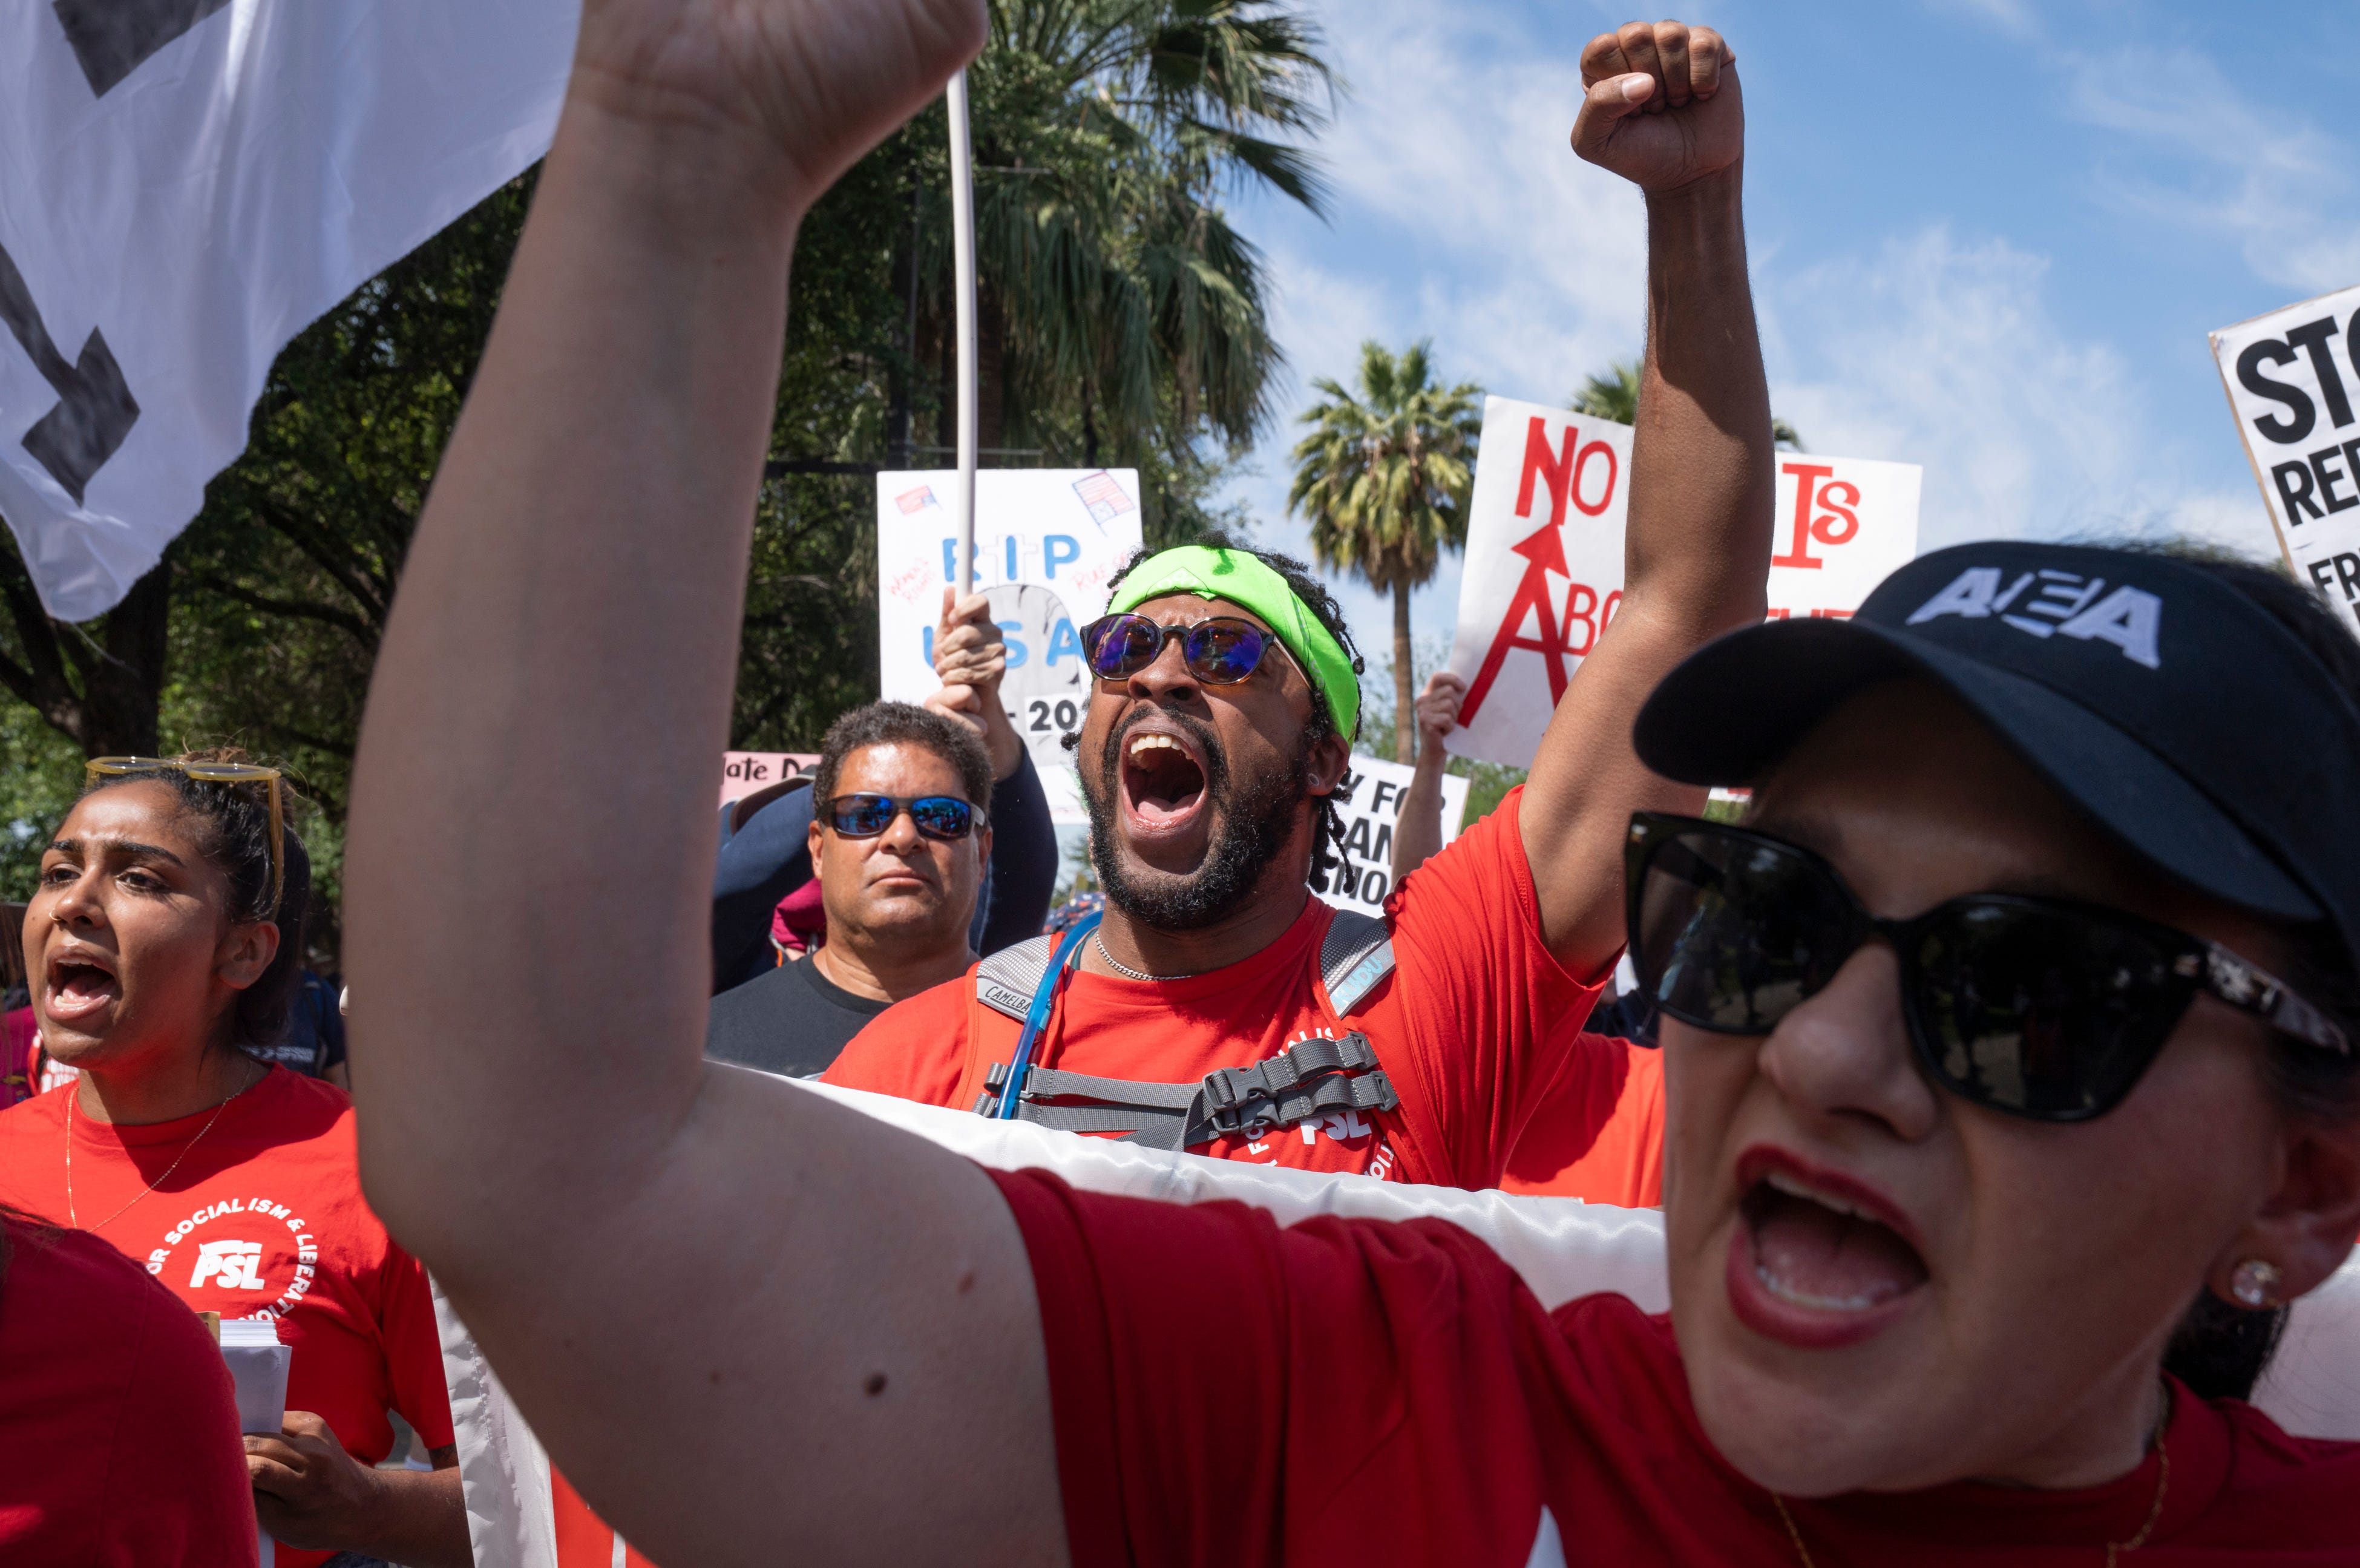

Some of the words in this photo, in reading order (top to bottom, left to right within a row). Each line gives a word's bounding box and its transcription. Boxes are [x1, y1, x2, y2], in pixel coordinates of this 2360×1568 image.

[1515, 416, 1618, 525] NO
[2307, 548, 2360, 601] FR
[165, 1198, 291, 1245] SOCIALISM
[286, 1218, 305, 1233] &
[189, 1240, 265, 1290] PSL
